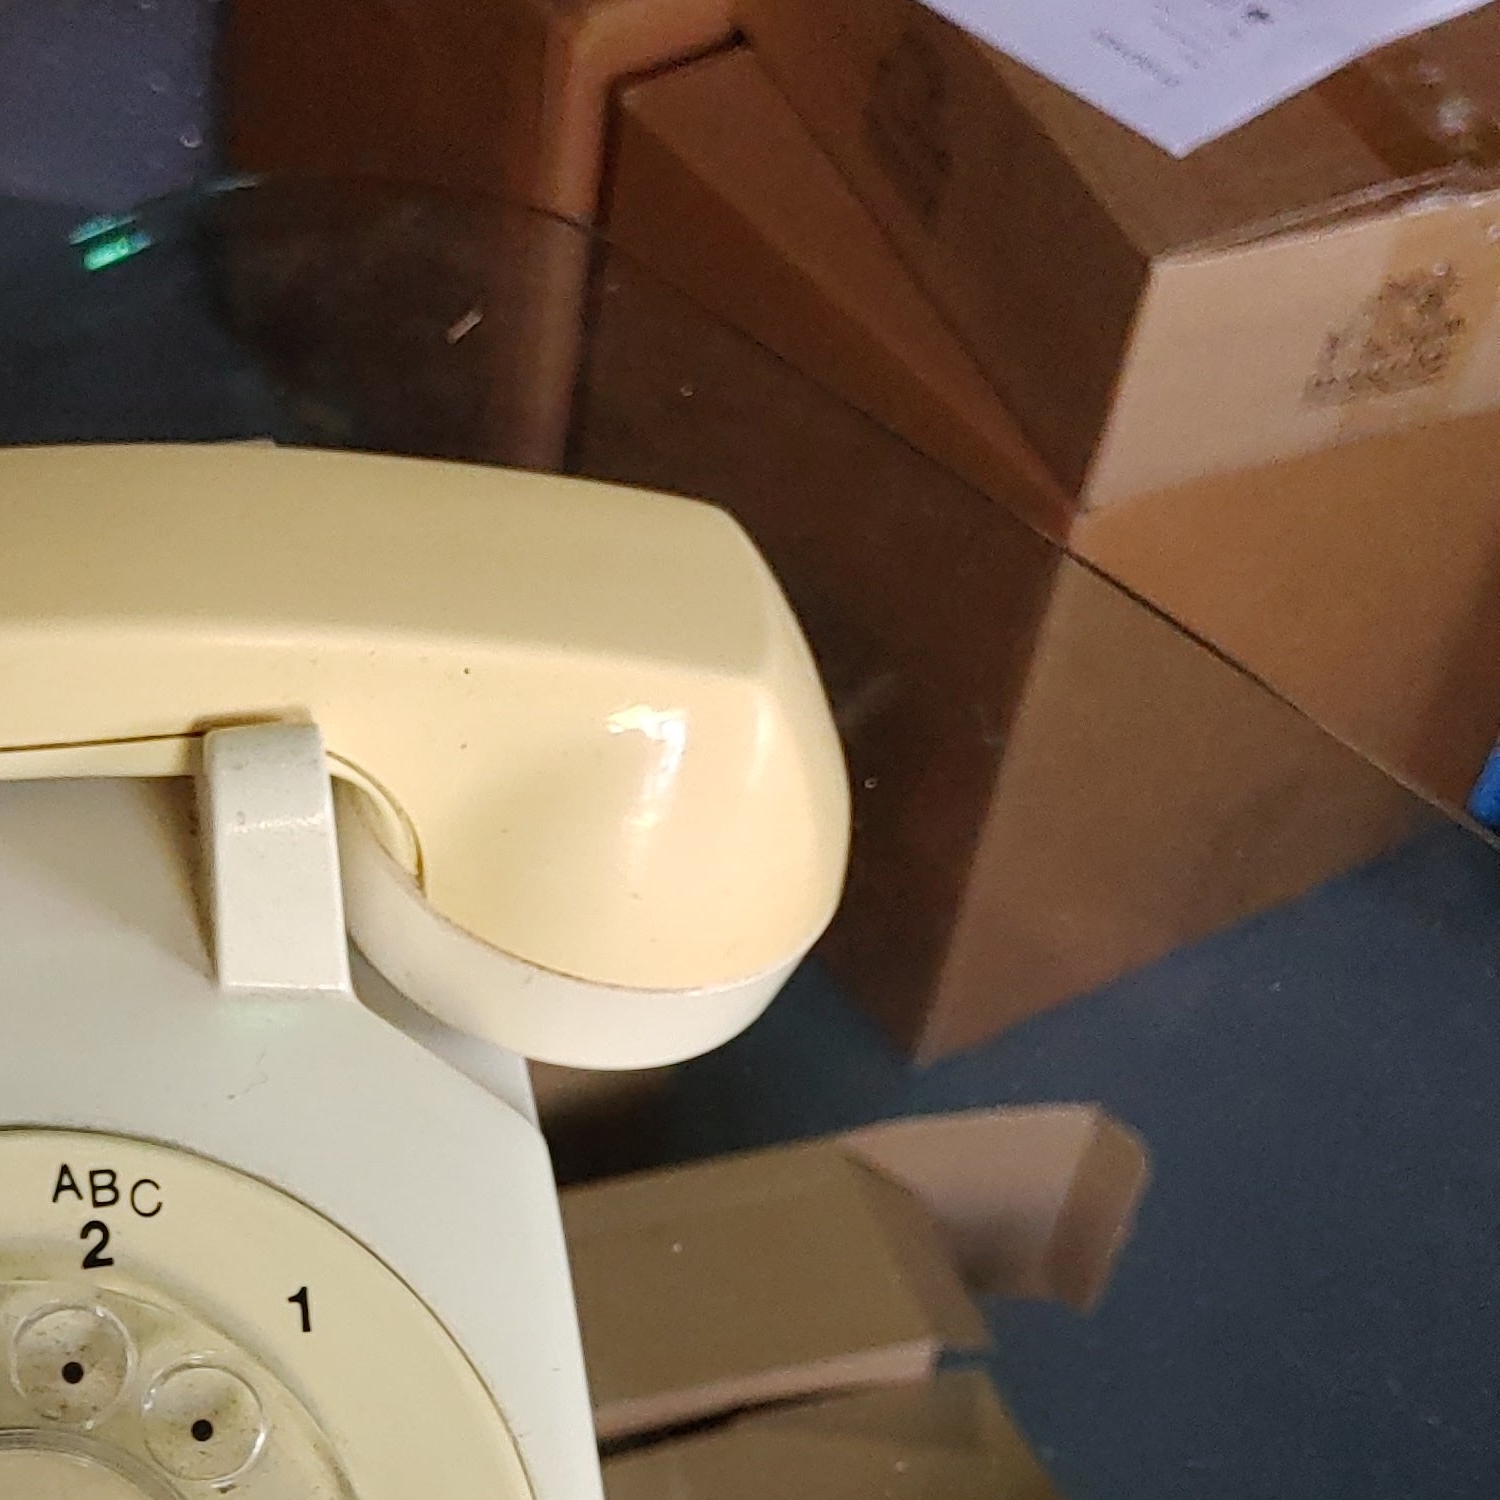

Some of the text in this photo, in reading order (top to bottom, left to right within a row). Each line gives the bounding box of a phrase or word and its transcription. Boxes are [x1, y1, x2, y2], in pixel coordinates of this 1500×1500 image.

[52, 1163, 163, 1218] ABC
[80, 1220, 114, 1270] 2
[287, 1286, 313, 1333] 1
